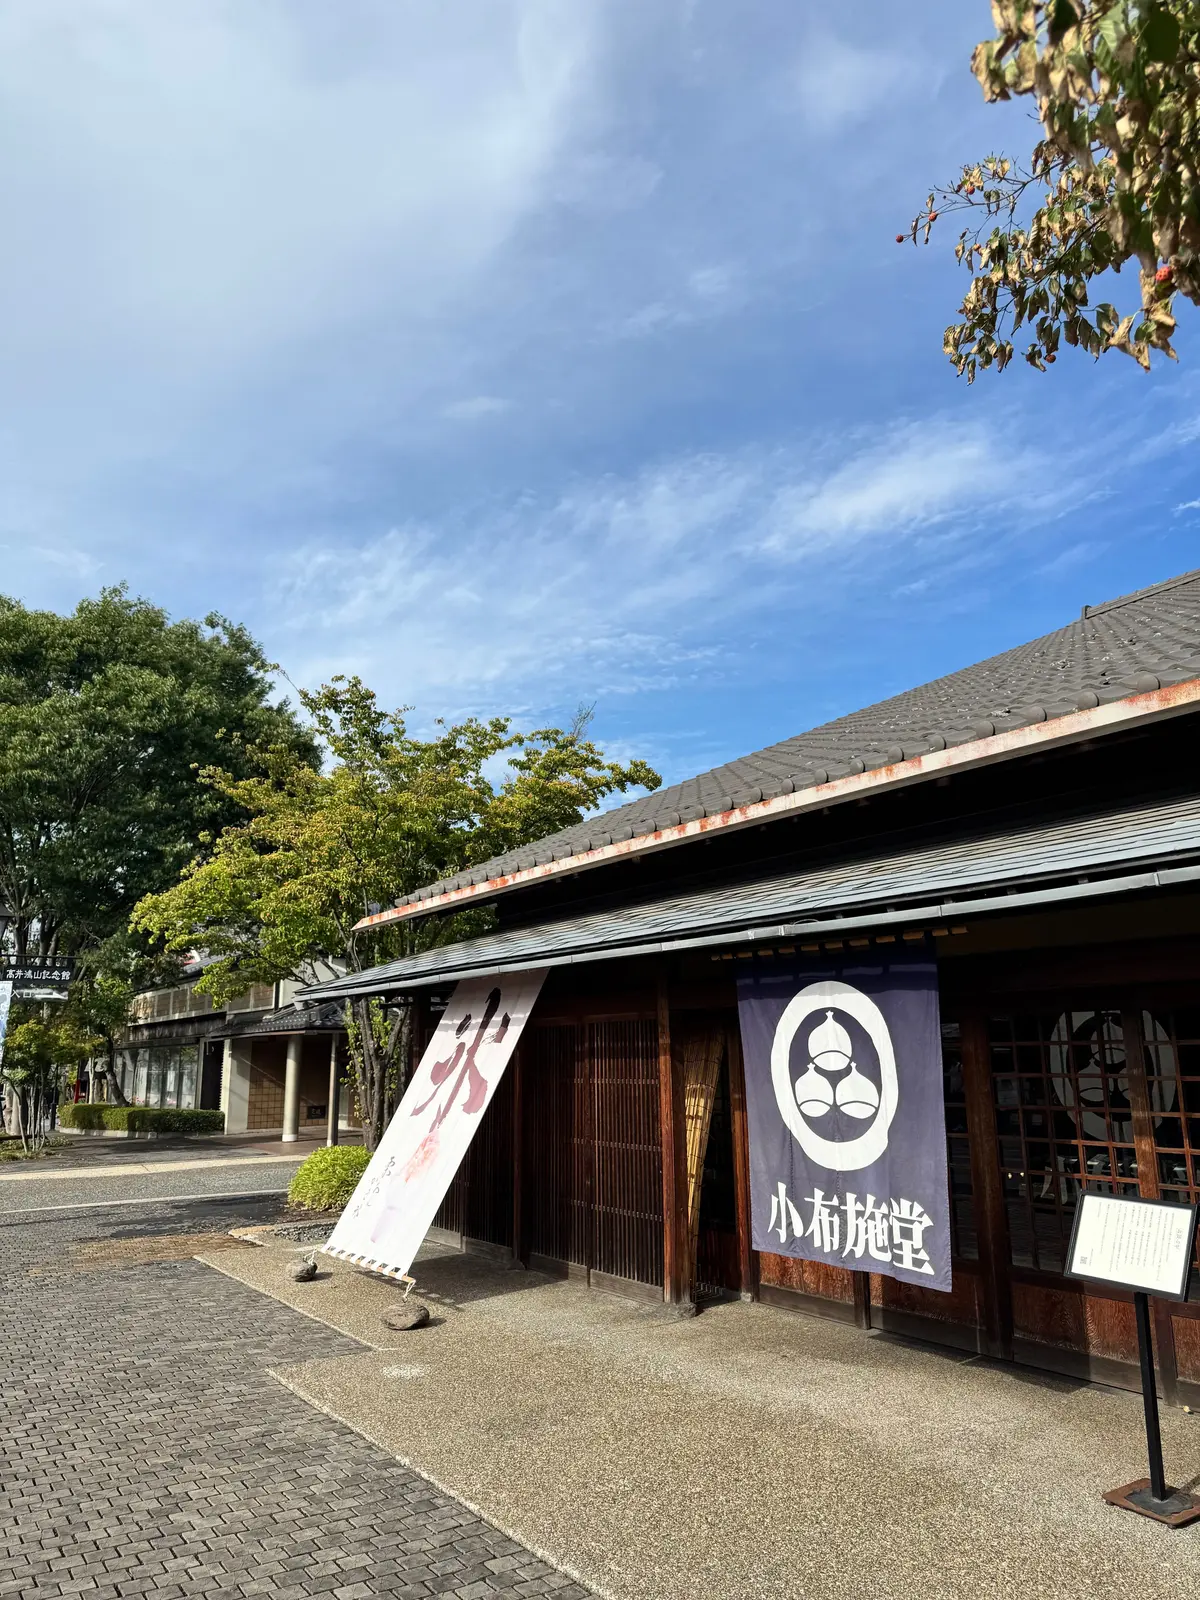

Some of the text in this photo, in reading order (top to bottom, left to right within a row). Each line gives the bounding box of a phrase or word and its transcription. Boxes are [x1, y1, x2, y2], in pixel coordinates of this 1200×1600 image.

[10, 989, 32, 998] 入口
[768, 1181, 936, 1276] 小布施堂
